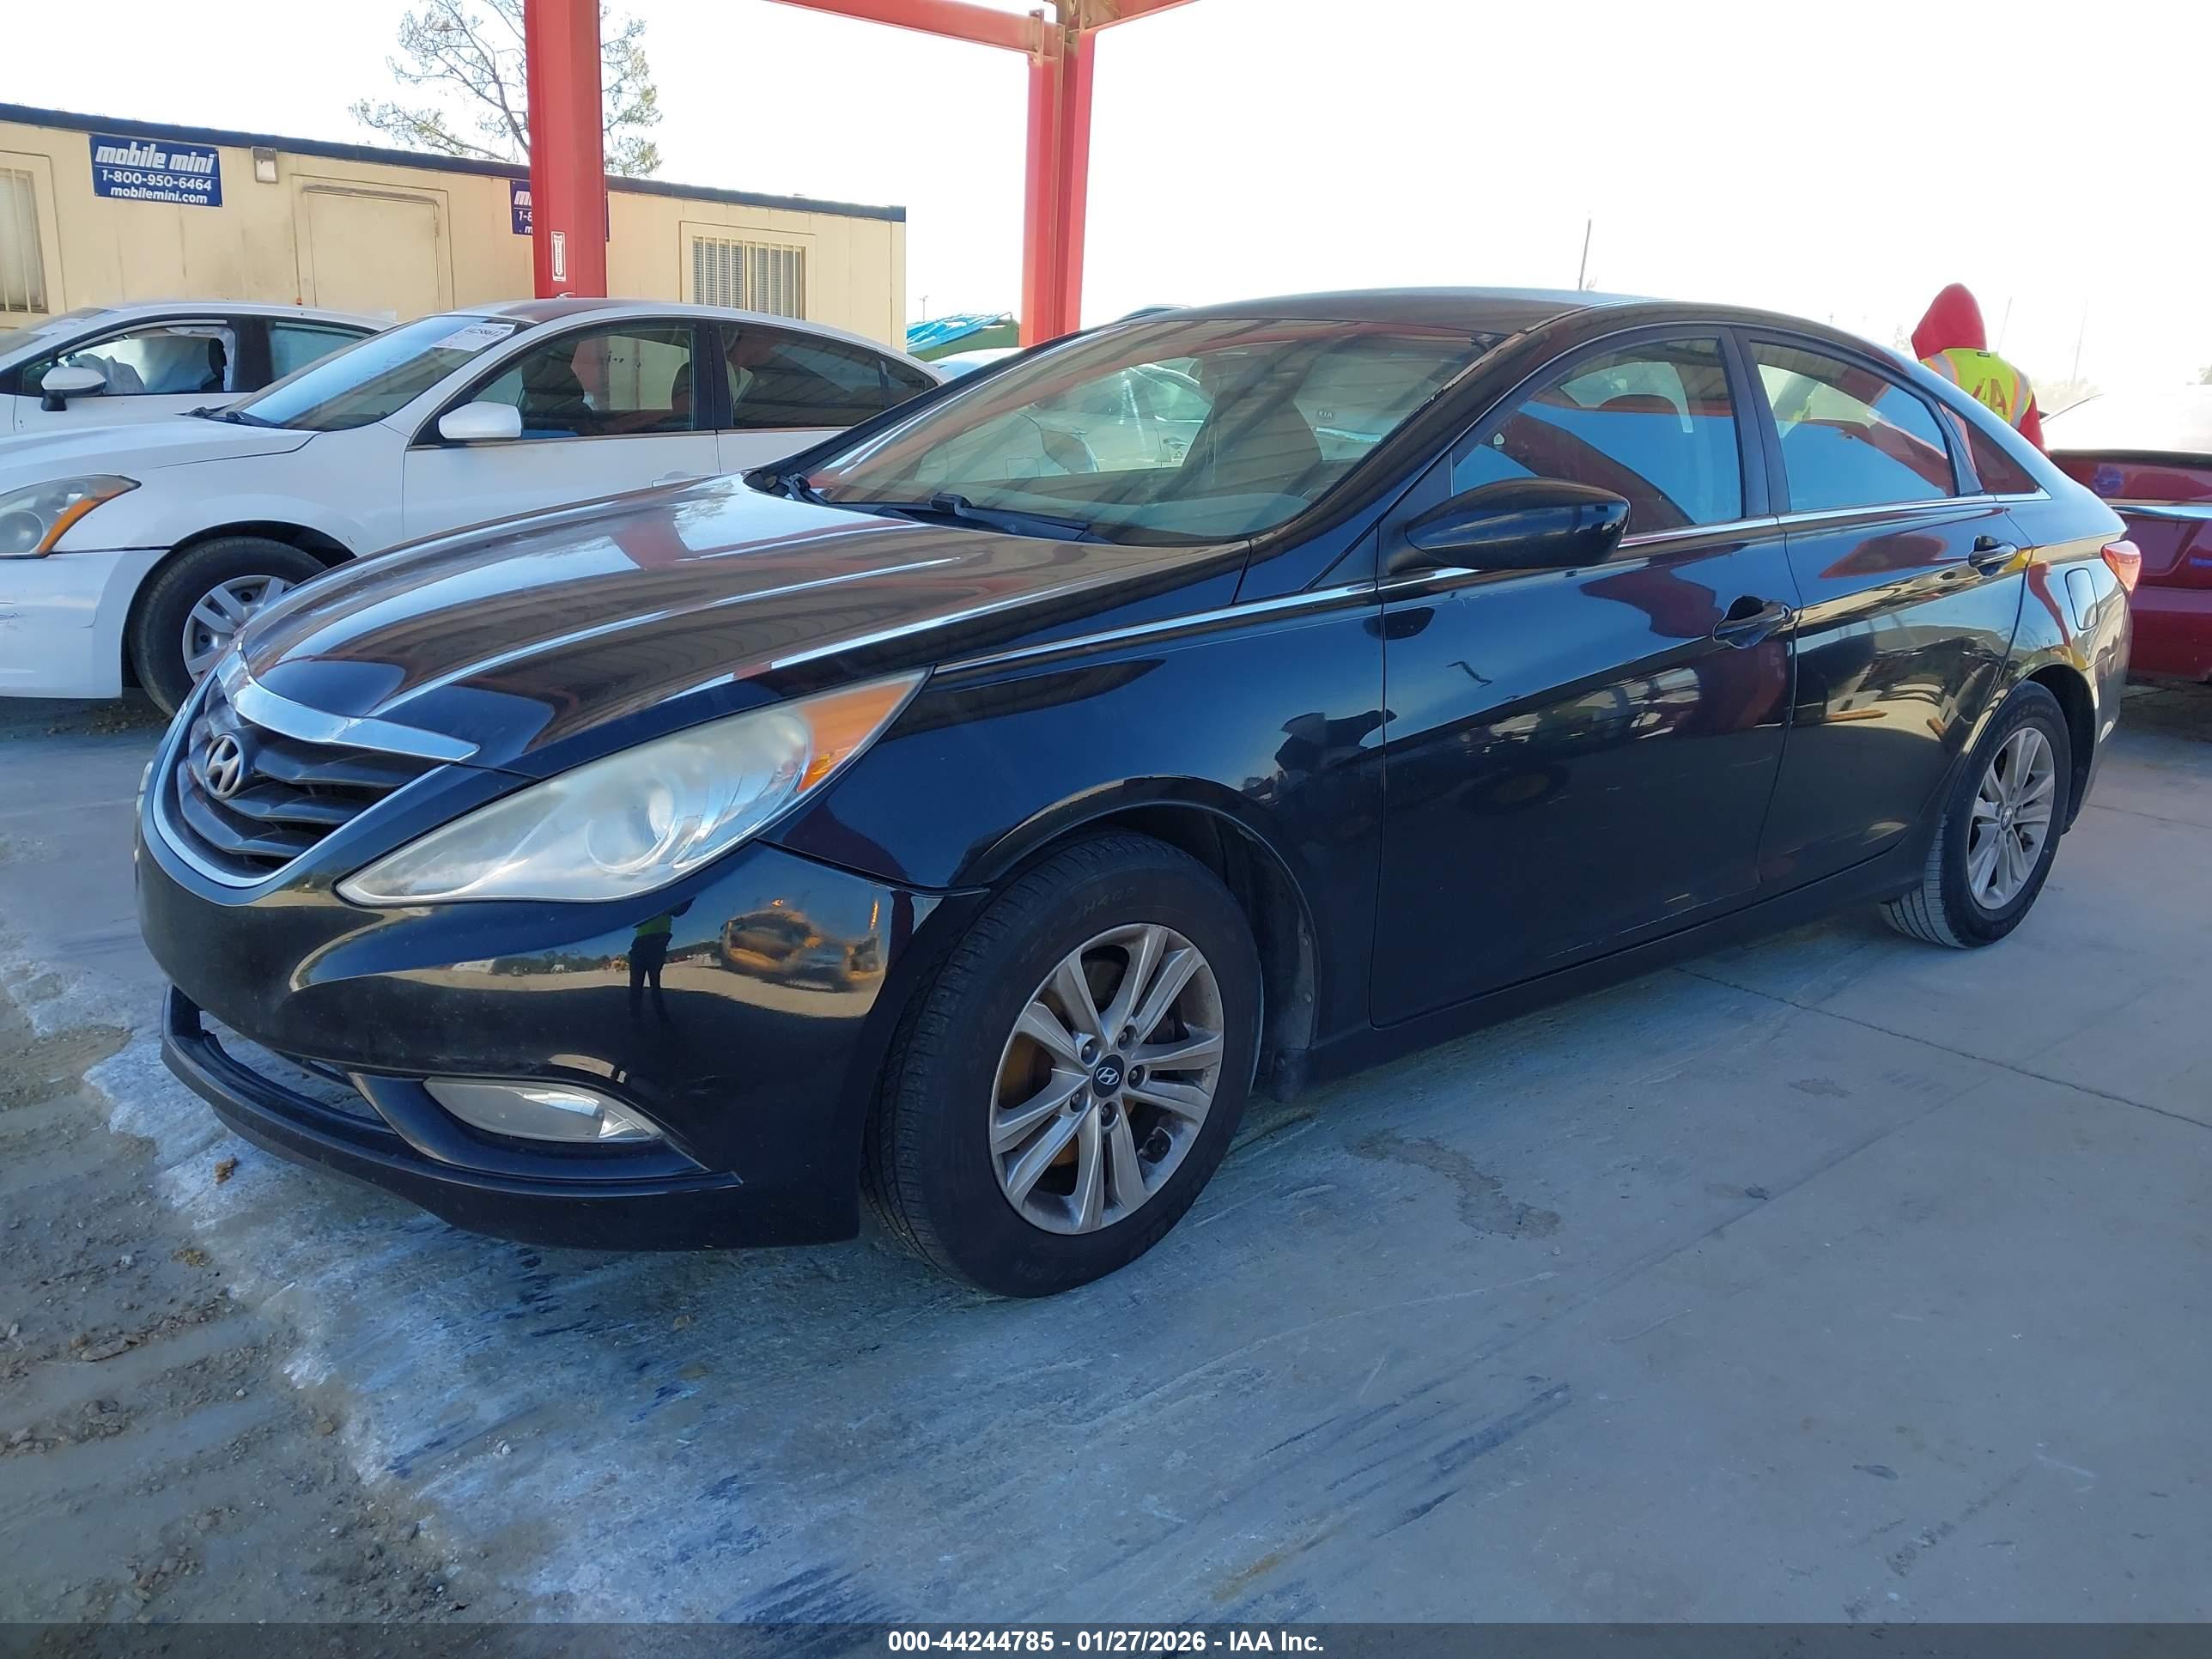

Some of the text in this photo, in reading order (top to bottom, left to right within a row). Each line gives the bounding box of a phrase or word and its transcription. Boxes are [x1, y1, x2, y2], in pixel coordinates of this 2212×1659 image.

[95, 141, 216, 173] mobile mini
[101, 170, 212, 191] 1-800-950-6464
[110, 186, 208, 204] mobilemini.com
